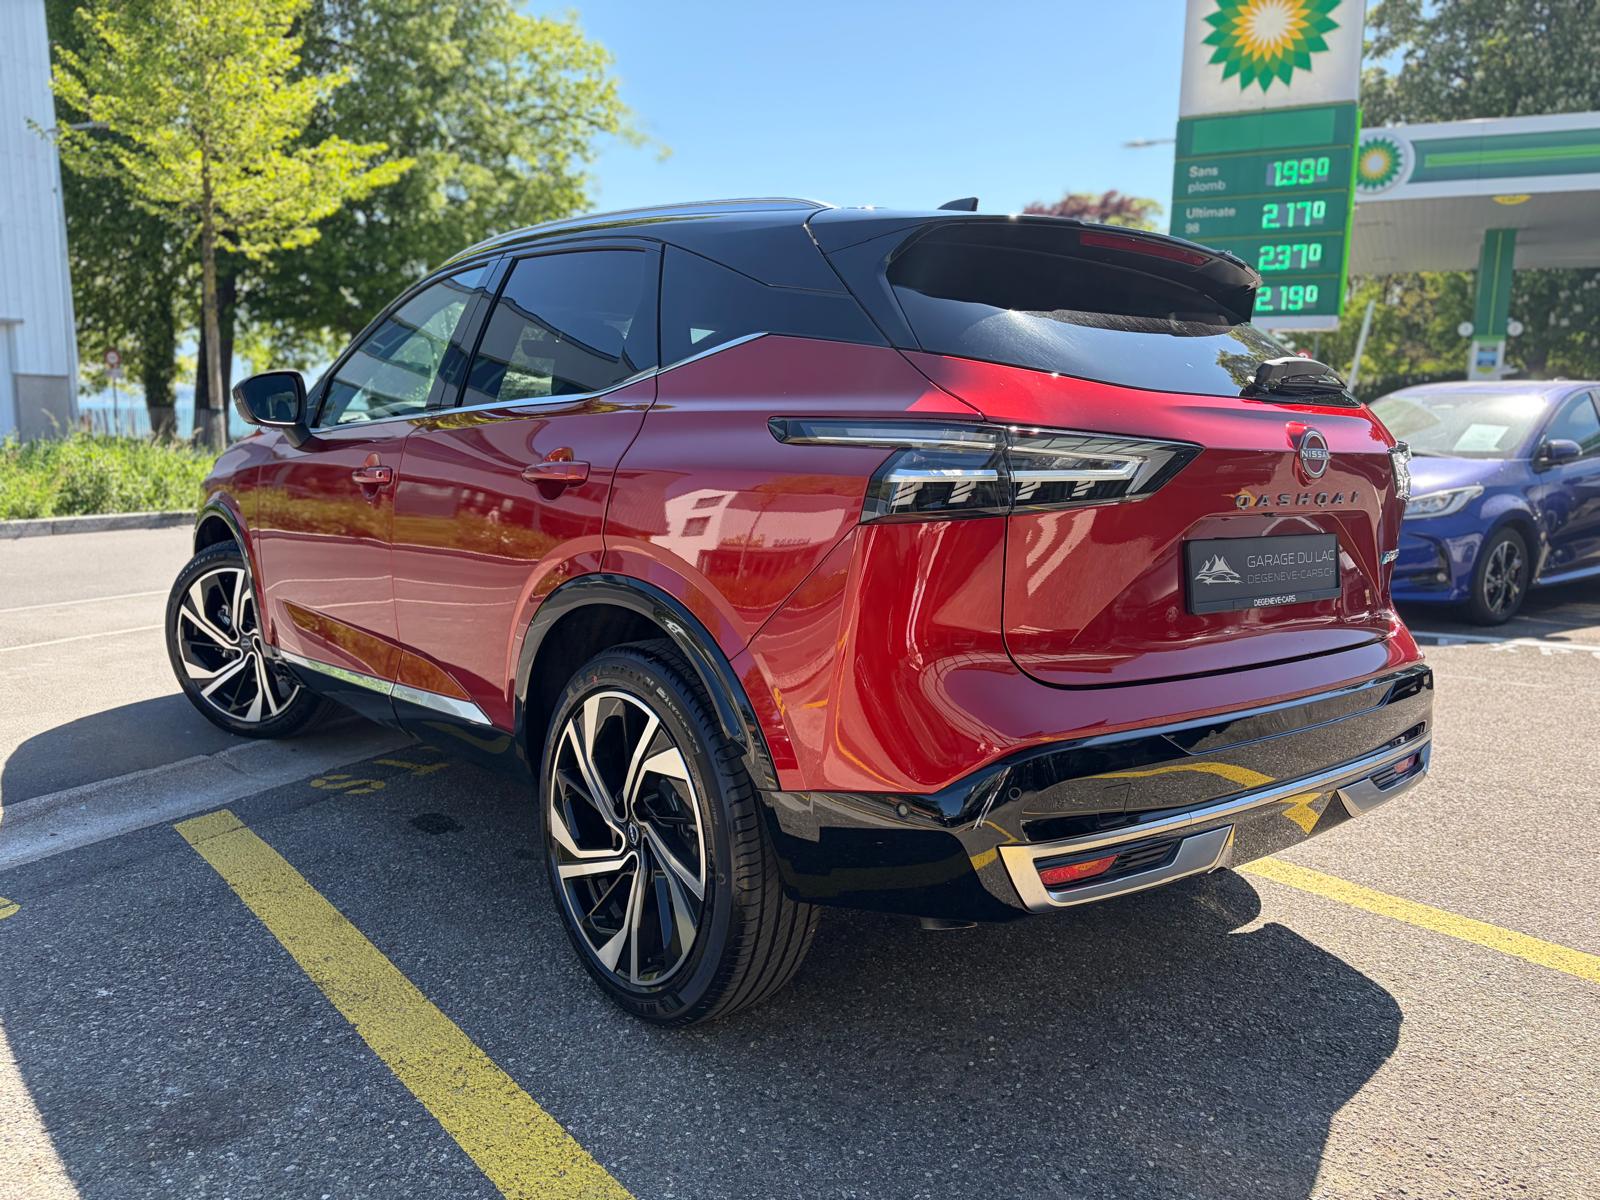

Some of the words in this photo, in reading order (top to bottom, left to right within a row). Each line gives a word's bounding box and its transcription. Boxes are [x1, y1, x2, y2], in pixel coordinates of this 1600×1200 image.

[1189, 166, 1218, 178] Sans
[1188, 180, 1226, 194] plomb
[1186, 206, 1237, 219] Ultimate
[1301, 450, 1328, 458] NISSA
[1235, 491, 1360, 510] QASHQAI
[1247, 552, 1295, 568] GARAGE
[1298, 552, 1313, 564] DU
[1316, 549, 1335, 562] LAC
